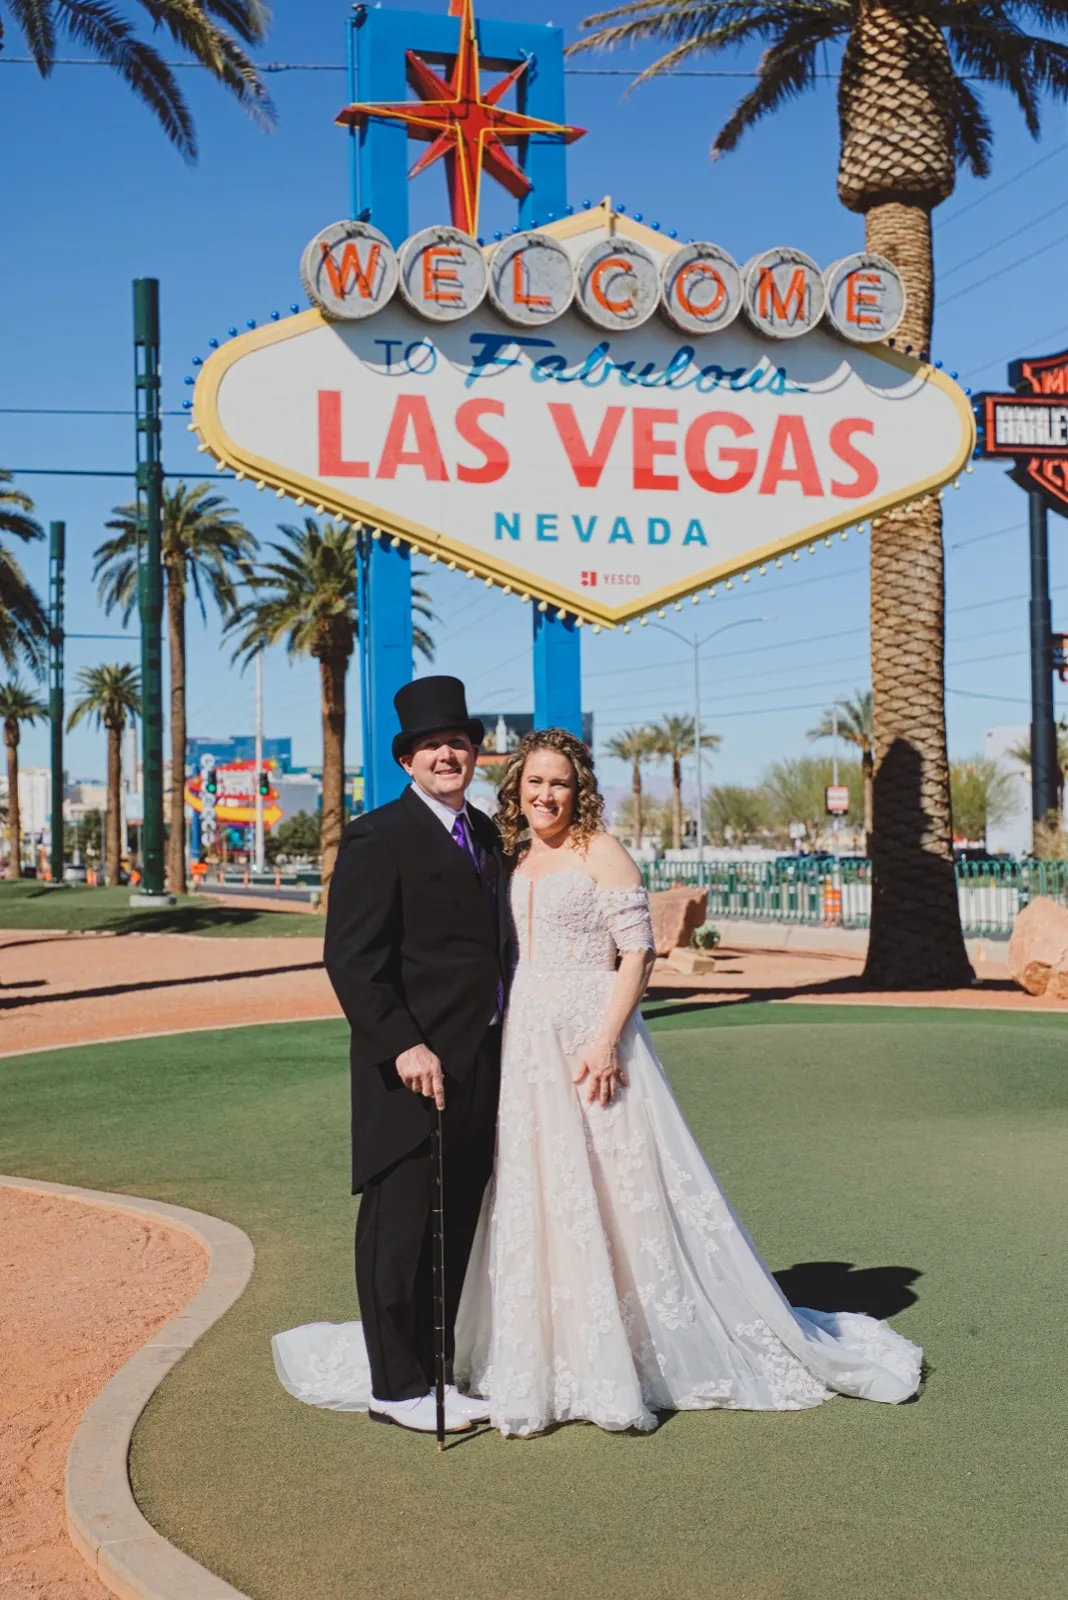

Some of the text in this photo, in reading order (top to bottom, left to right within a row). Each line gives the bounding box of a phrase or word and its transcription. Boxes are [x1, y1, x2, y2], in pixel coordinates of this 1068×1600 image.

[319, 241, 884, 327] WELCOME
[374, 332, 808, 395] TO Fabulous
[317, 389, 879, 499] LAS VEGAS
[494, 511, 709, 547] NEVADA
[602, 573, 641, 586] YESCO
